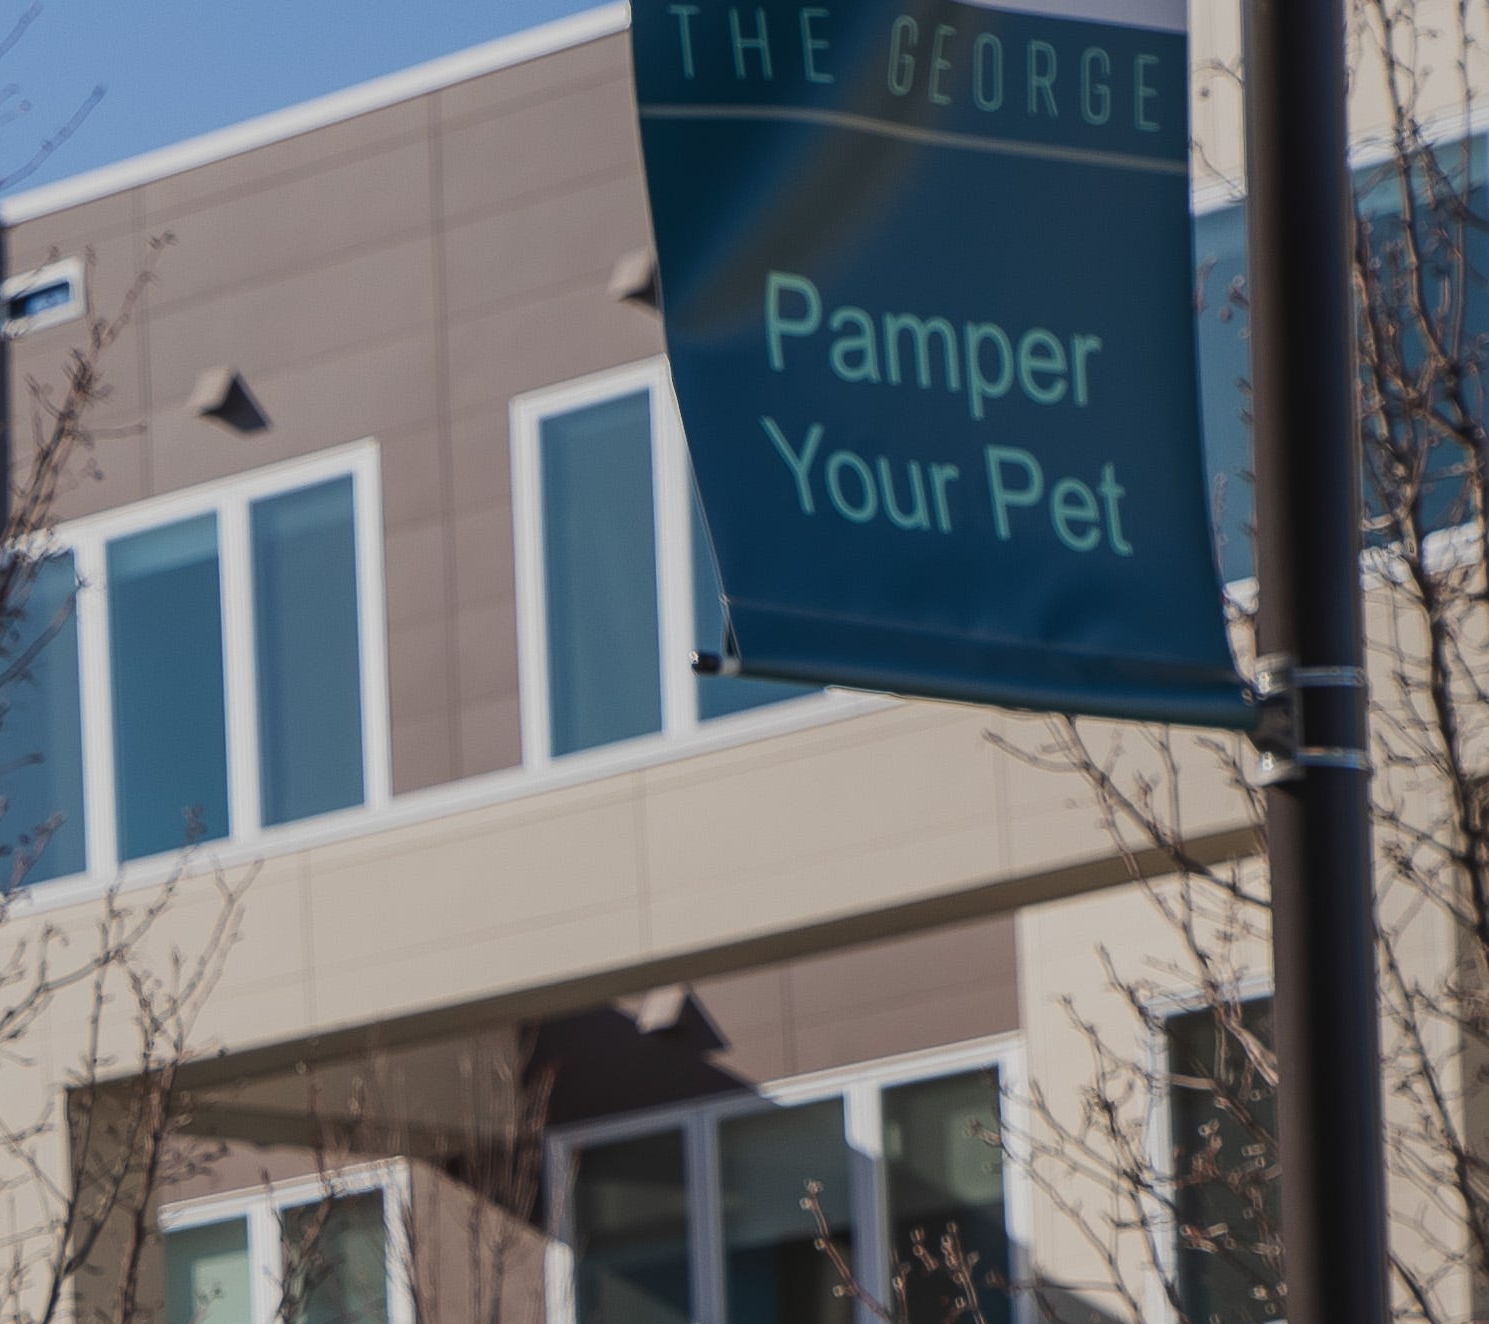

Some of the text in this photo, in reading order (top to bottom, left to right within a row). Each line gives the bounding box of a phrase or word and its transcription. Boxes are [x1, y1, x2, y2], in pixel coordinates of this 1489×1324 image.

[666, 3, 1162, 132] THE GEORGE
[763, 272, 1103, 420] Pamper
[759, 415, 1134, 556] Your Pet
